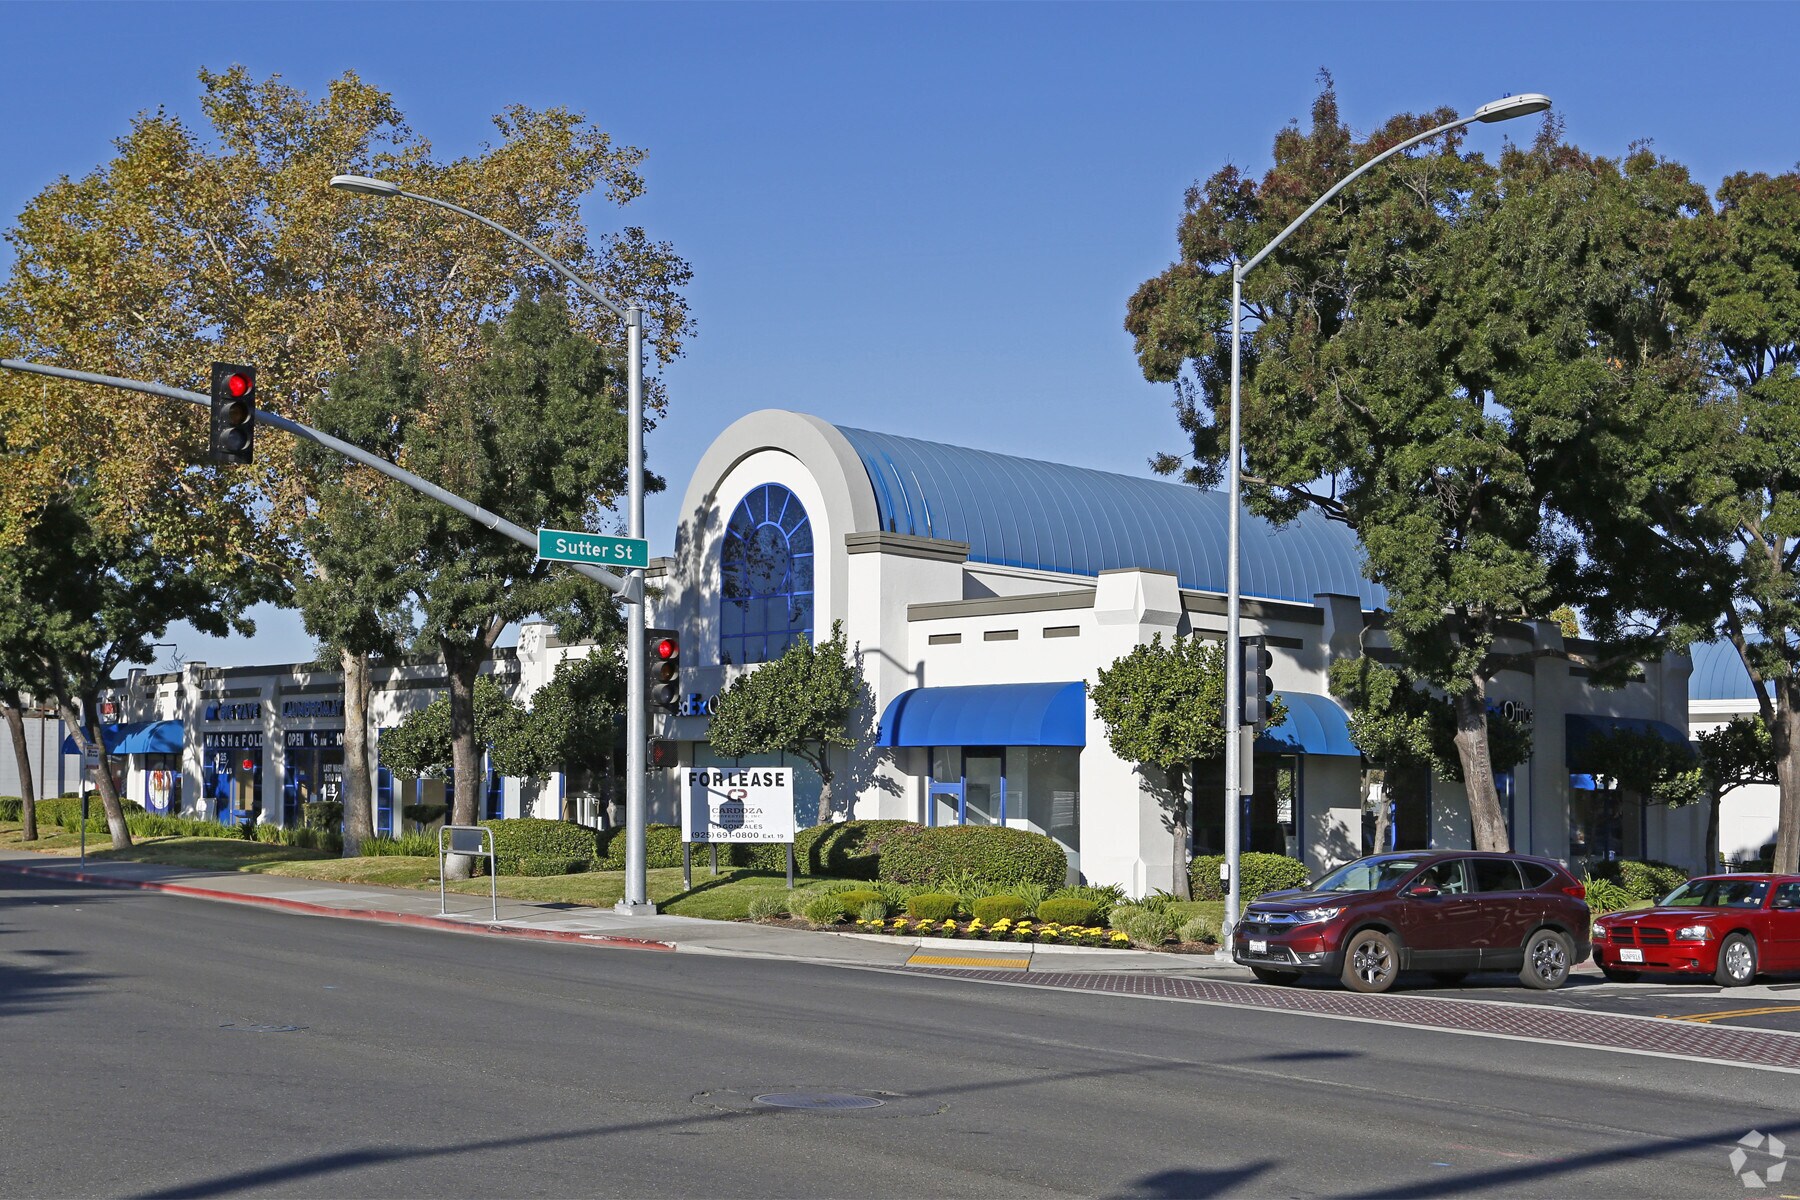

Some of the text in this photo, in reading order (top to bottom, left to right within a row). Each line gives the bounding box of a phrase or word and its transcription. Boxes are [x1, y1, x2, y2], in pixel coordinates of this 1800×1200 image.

[556, 538, 633, 560] Sutter St
[1504, 700, 1534, 724] Office
[206, 733, 263, 747] WASH & FOLD
[287, 733, 304, 746] OPEN
[688, 772, 785, 788] FOR LEASE
[691, 831, 715, 840] (925)
[716, 831, 759, 839] 691-0800
